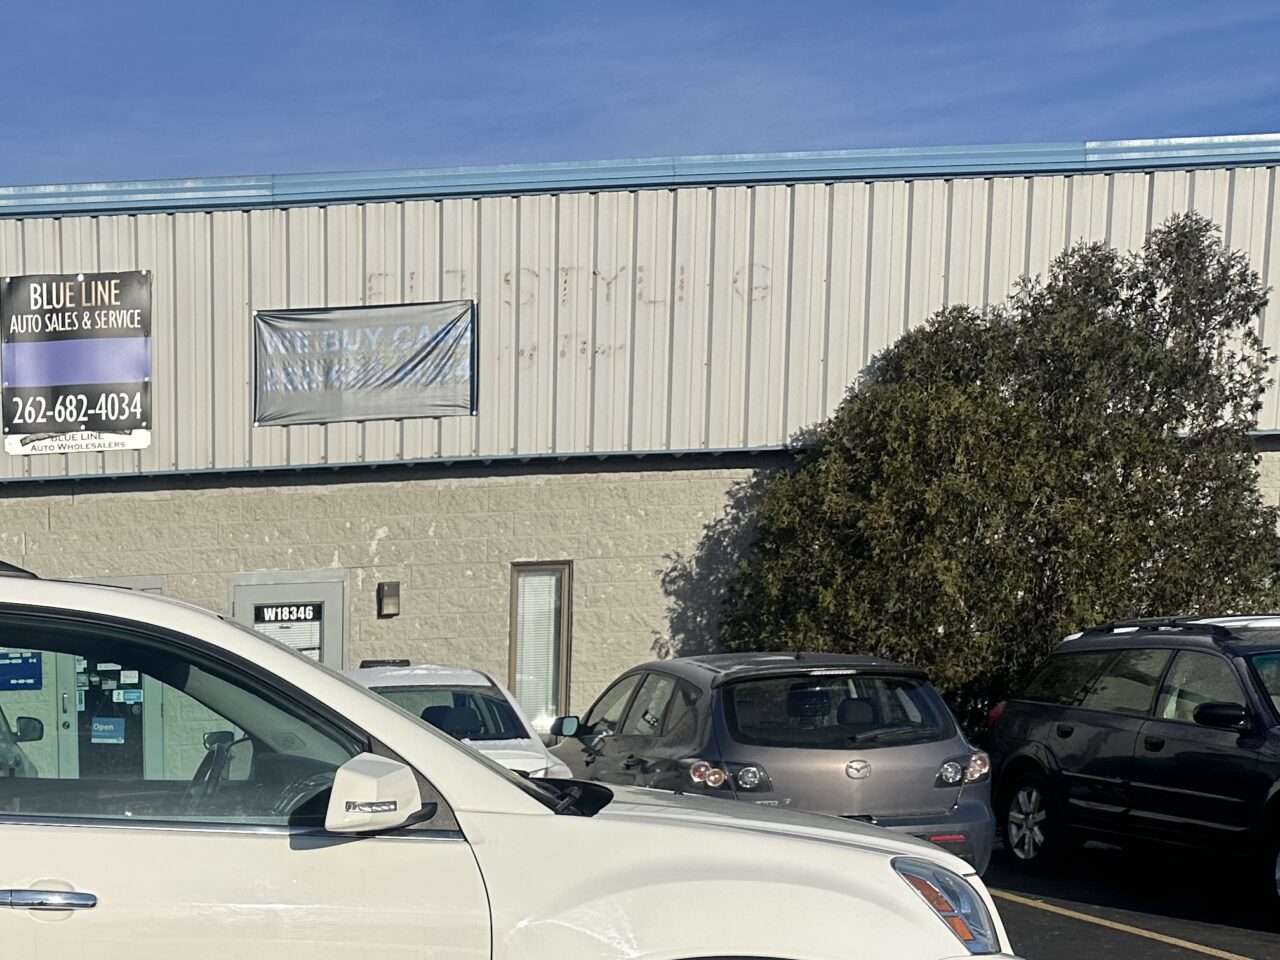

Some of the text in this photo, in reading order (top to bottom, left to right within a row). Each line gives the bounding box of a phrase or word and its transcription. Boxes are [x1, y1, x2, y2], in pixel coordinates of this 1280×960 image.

[29, 279, 121, 310] BLUE LINE
[9, 309, 141, 334] AUTO SALES & SERVICE
[322, 326, 384, 351] BUY
[12, 391, 143, 424] 262-682-4034
[80, 431, 104, 440] LINE
[263, 605, 314, 621] W18346
[93, 723, 114, 731] Open
